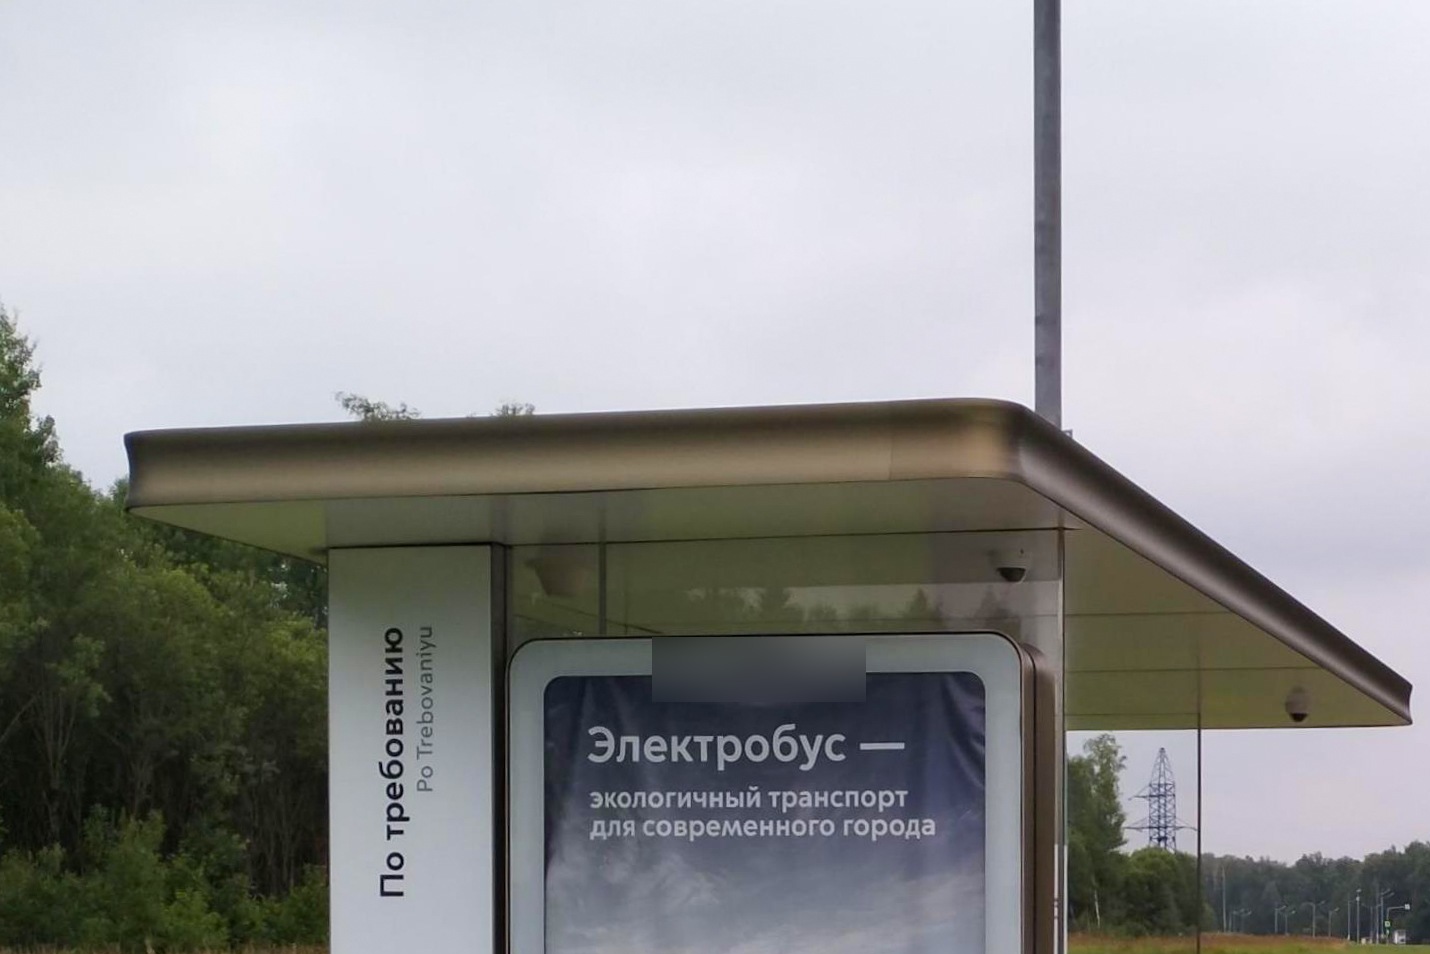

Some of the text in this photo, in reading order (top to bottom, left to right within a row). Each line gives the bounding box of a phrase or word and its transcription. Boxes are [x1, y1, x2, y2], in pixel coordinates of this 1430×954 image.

[416, 626, 437, 792] Po Trebovaniyu
[378, 627, 410, 897] По требованию
[587, 723, 847, 771] Электробус
[589, 785, 909, 812] экологичный транспорт
[589, 814, 937, 842] для современного города
